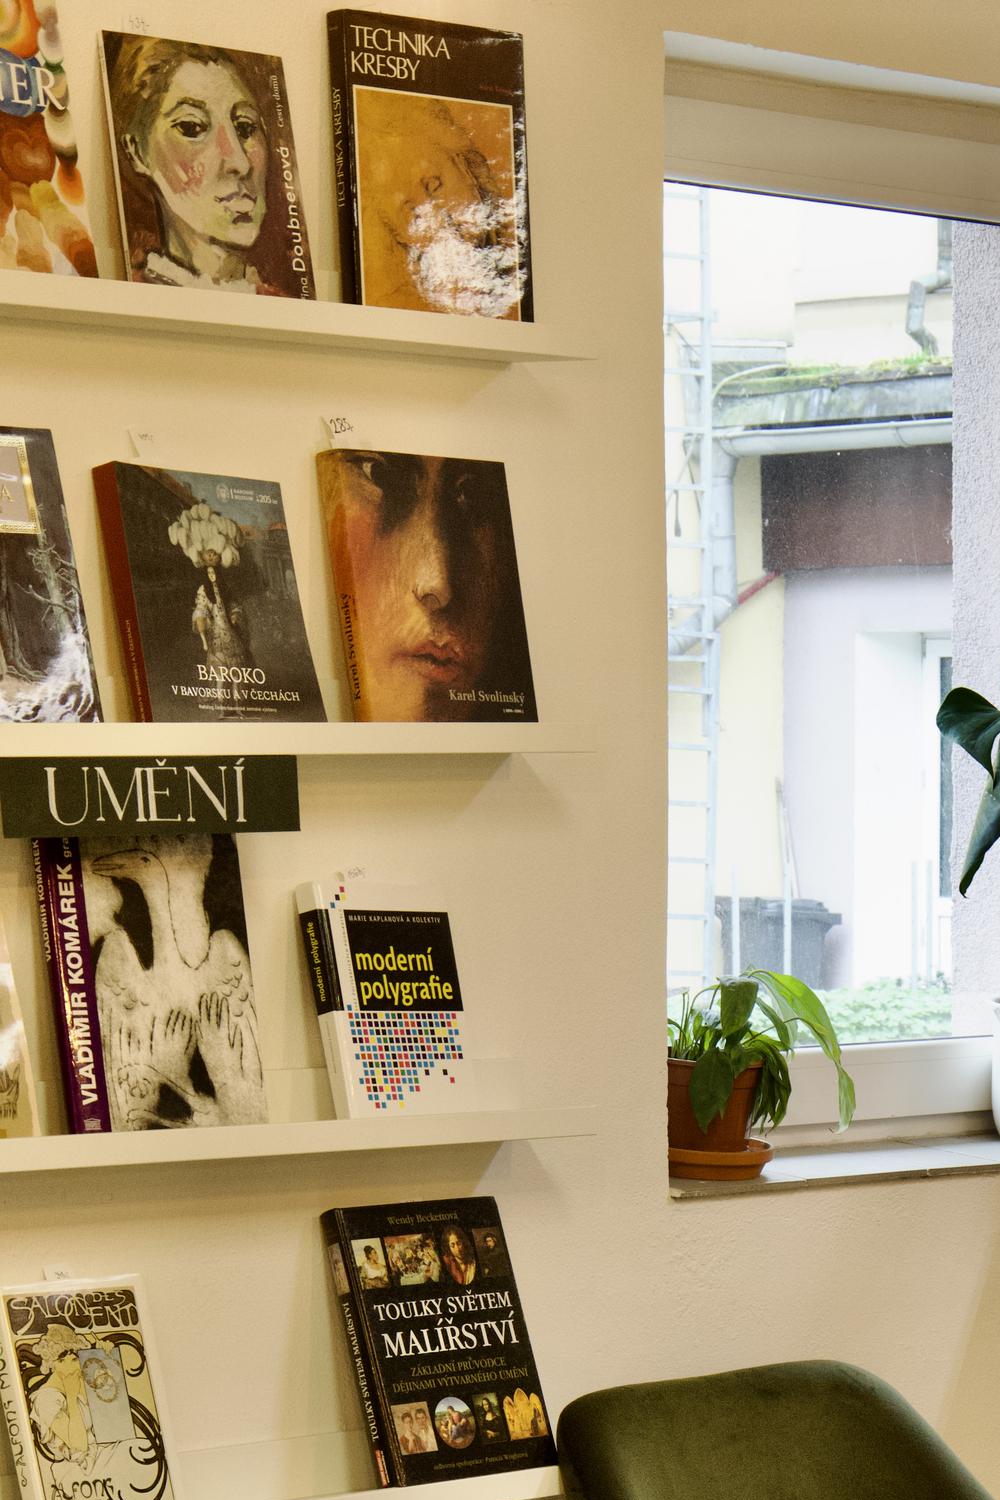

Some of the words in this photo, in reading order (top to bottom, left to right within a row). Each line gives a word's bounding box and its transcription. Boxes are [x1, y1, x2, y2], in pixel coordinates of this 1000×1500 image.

[350, 24, 451, 59] TECHNIKA
[351, 51, 420, 80] KRESBY
[332, 87, 342, 136] KRESBY
[335, 139, 346, 208] TECHNIKA
[277, 147, 307, 273] Doubnerová
[197, 664, 266, 685] BAROKO
[171, 685, 179, 695] V
[180, 685, 231, 699] BAVORSKU
[233, 690, 240, 700] A
[242, 690, 249, 700] V
[251, 688, 301, 702] ČECHÁCH
[449, 690, 476, 701] Karel
[478, 690, 525, 706] Svolinský
[44, 758, 248, 827] UMĚNÍ
[56, 864, 85, 985] KOMÁREK
[369, 915, 404, 923] KAPLANOVÁ
[306, 921, 322, 964] polygrafie
[355, 945, 434, 972] moderní
[313, 966, 326, 1002] moderní
[360, 974, 454, 1007] polygrafie
[387, 1216, 415, 1226] Wendy
[416, 1211, 459, 1223] Beckettová
[10, 1295, 89, 1335] SALON
[374, 1298, 443, 1321] TOULKY
[447, 1290, 513, 1314] SVĚTEM
[381, 1310, 519, 1359] MALÍŘSTVÍ
[392, 1379, 436, 1394] DĚJINAMI
[437, 1373, 498, 1388] VÝTVARNÉHO
[500, 1368, 529, 1380] UMĚNÍ
[411, 1361, 456, 1377] ZÁKLADNÍ
[457, 1356, 507, 1374] PRŮVODCE
[364, 1402, 379, 1443] TOULKY
